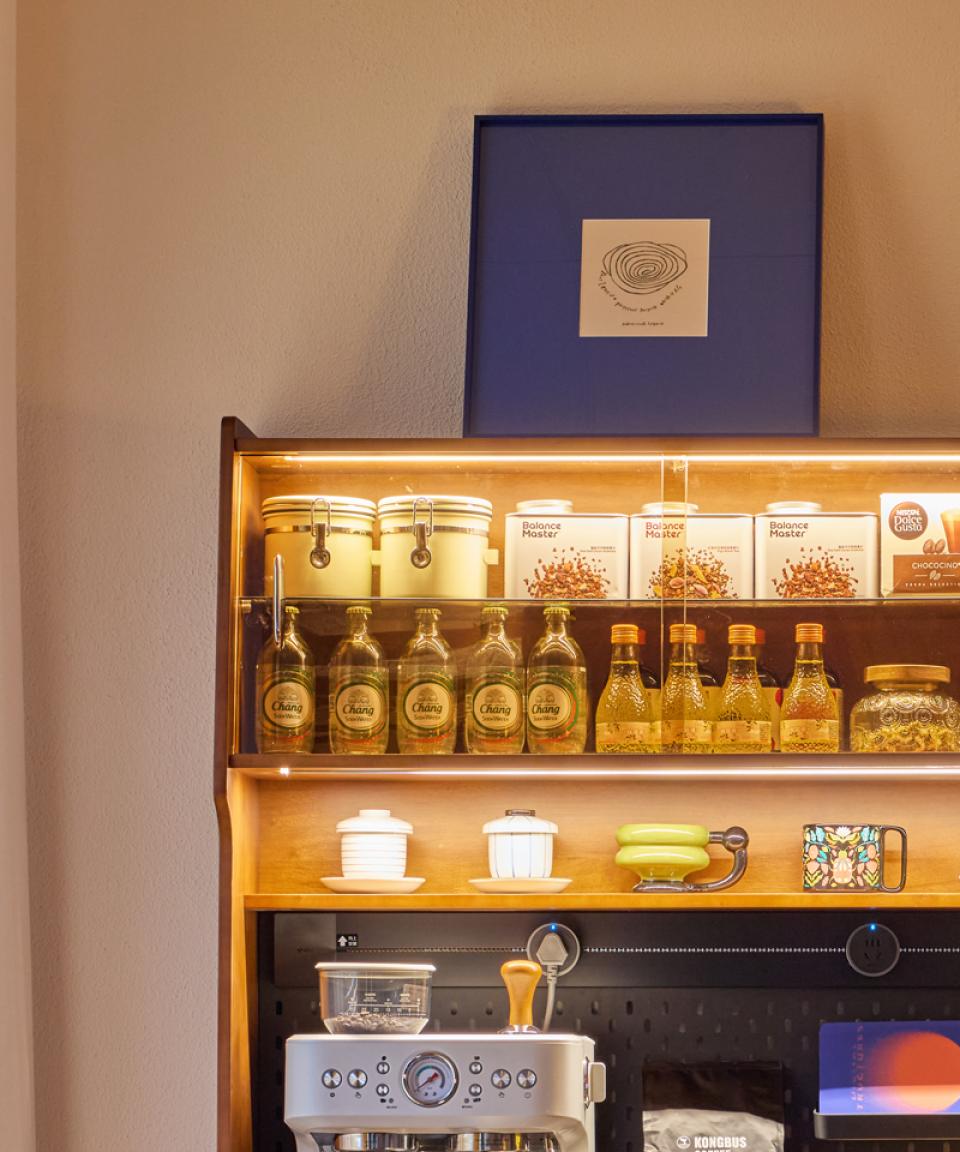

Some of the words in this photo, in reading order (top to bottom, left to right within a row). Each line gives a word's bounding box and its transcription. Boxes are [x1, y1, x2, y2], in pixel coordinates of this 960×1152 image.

[894, 515, 923, 524] Dolce
[522, 521, 562, 530] Balance
[645, 522, 685, 530] Balance
[769, 521, 809, 530] Balance
[894, 523, 923, 532] Gusto
[522, 530, 558, 538] Master
[645, 530, 681, 539] Master
[769, 529, 806, 538] Master
[271, 701, 303, 714] Chang
[342, 704, 375, 716] Chang
[412, 702, 443, 715] Chang
[479, 704, 511, 716] Chang
[531, 704, 560, 715] Chang
[694, 1136, 747, 1149] KONGBUS
